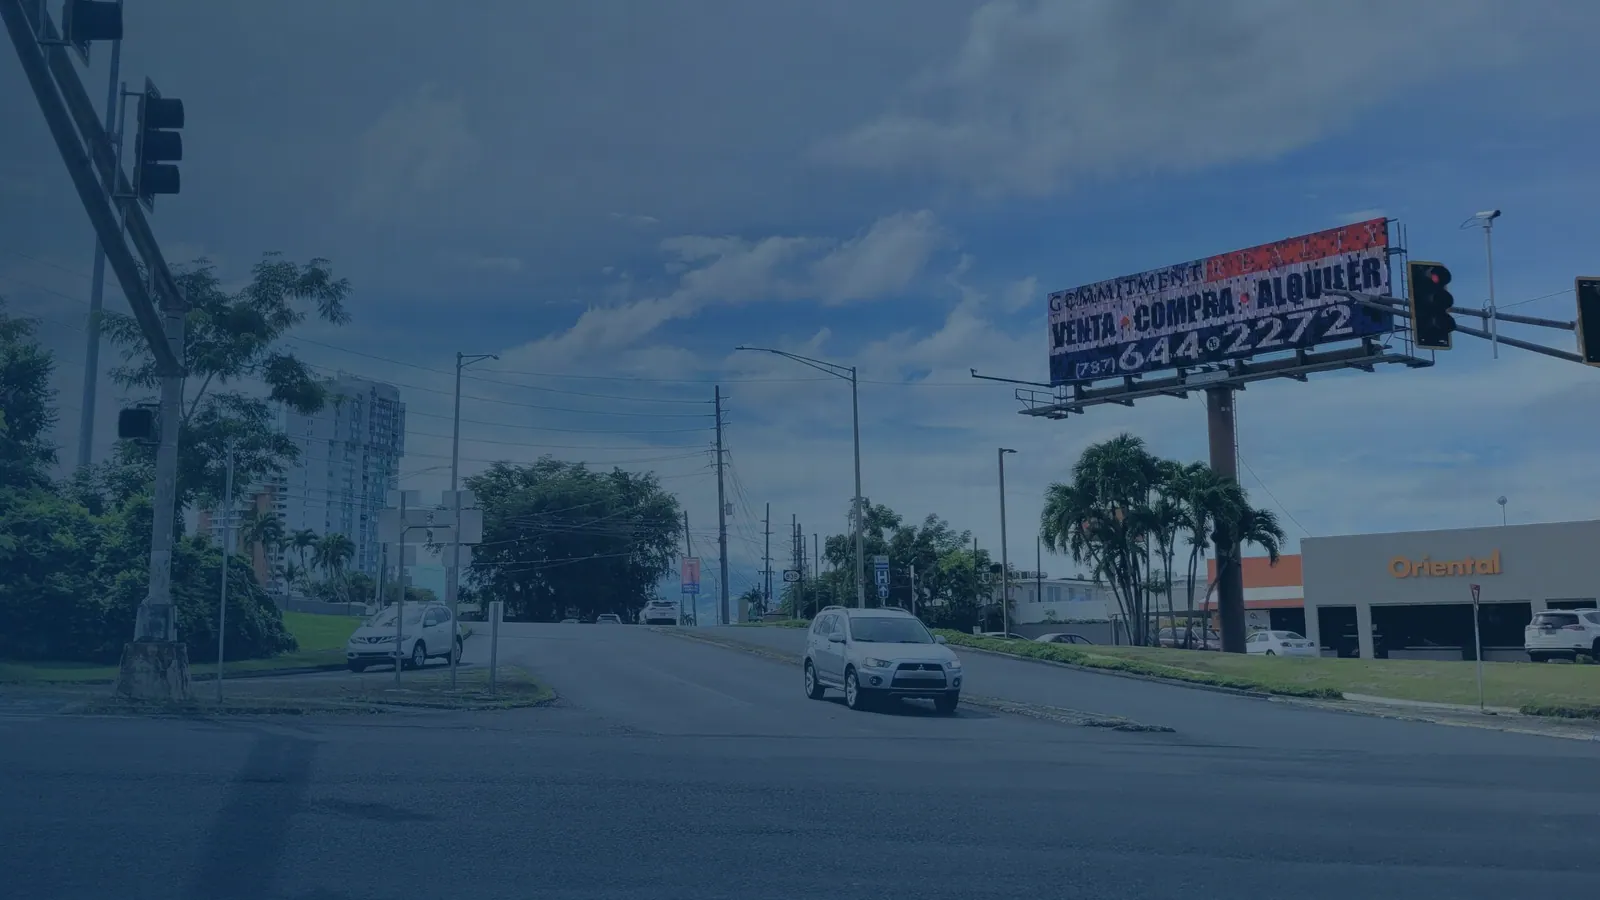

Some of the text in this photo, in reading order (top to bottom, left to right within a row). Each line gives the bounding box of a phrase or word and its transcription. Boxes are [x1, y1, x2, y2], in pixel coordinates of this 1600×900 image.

[1049, 224, 1380, 312] COMMITMENT REALTY
[1052, 258, 1381, 348] VENTA COMPRA ALQUILER
[1076, 357, 1115, 379] (787)
[877, 571, 887, 584] H
[1388, 549, 1501, 578] Oriental
